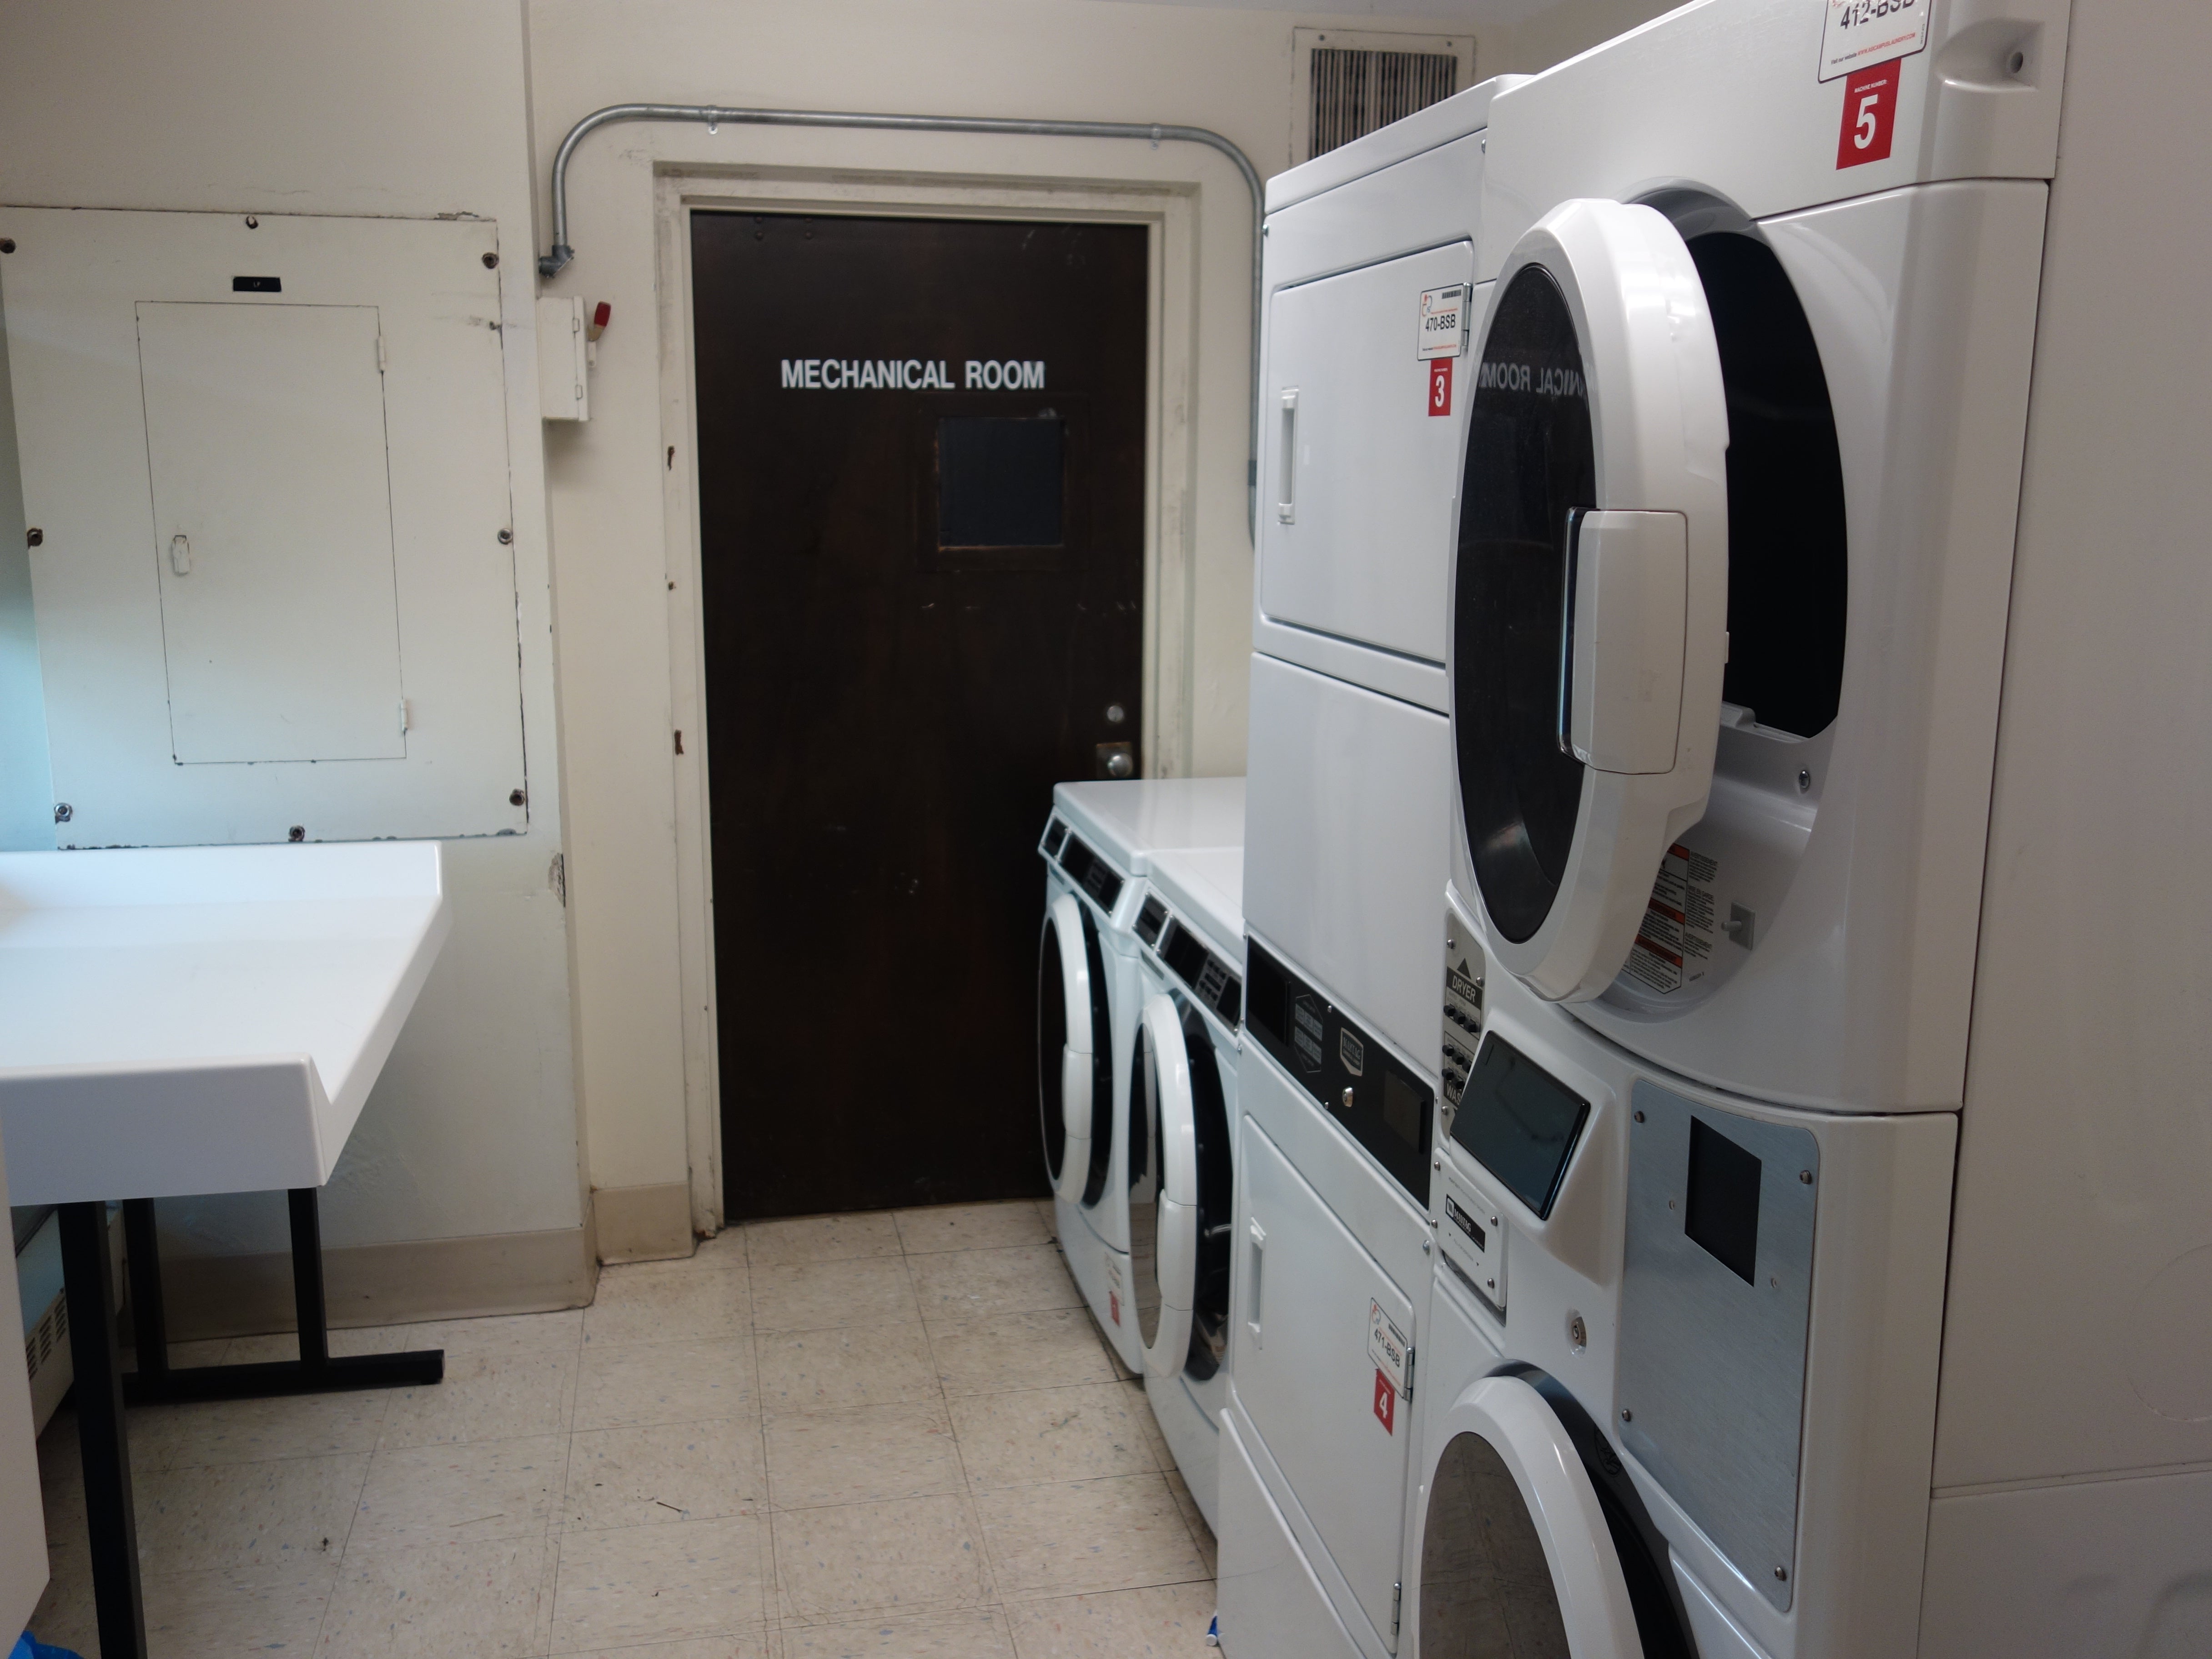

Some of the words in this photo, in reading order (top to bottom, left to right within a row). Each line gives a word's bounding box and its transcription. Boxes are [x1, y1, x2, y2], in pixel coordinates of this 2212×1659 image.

[1854, 94, 1878, 149] 5
[1425, 314, 1456, 332] 470-BSB
[781, 359, 955, 390] MECHANICAL
[965, 361, 1045, 389] ROOM
[1435, 375, 1445, 407] 3
[1452, 975, 1476, 1003] DRYER
[1447, 1083, 1462, 1105] WAS
[1454, 1208, 1472, 1232] MAYTAG
[1374, 1328, 1400, 1367] 471-BSB
[1379, 1392, 1388, 1419] 4
